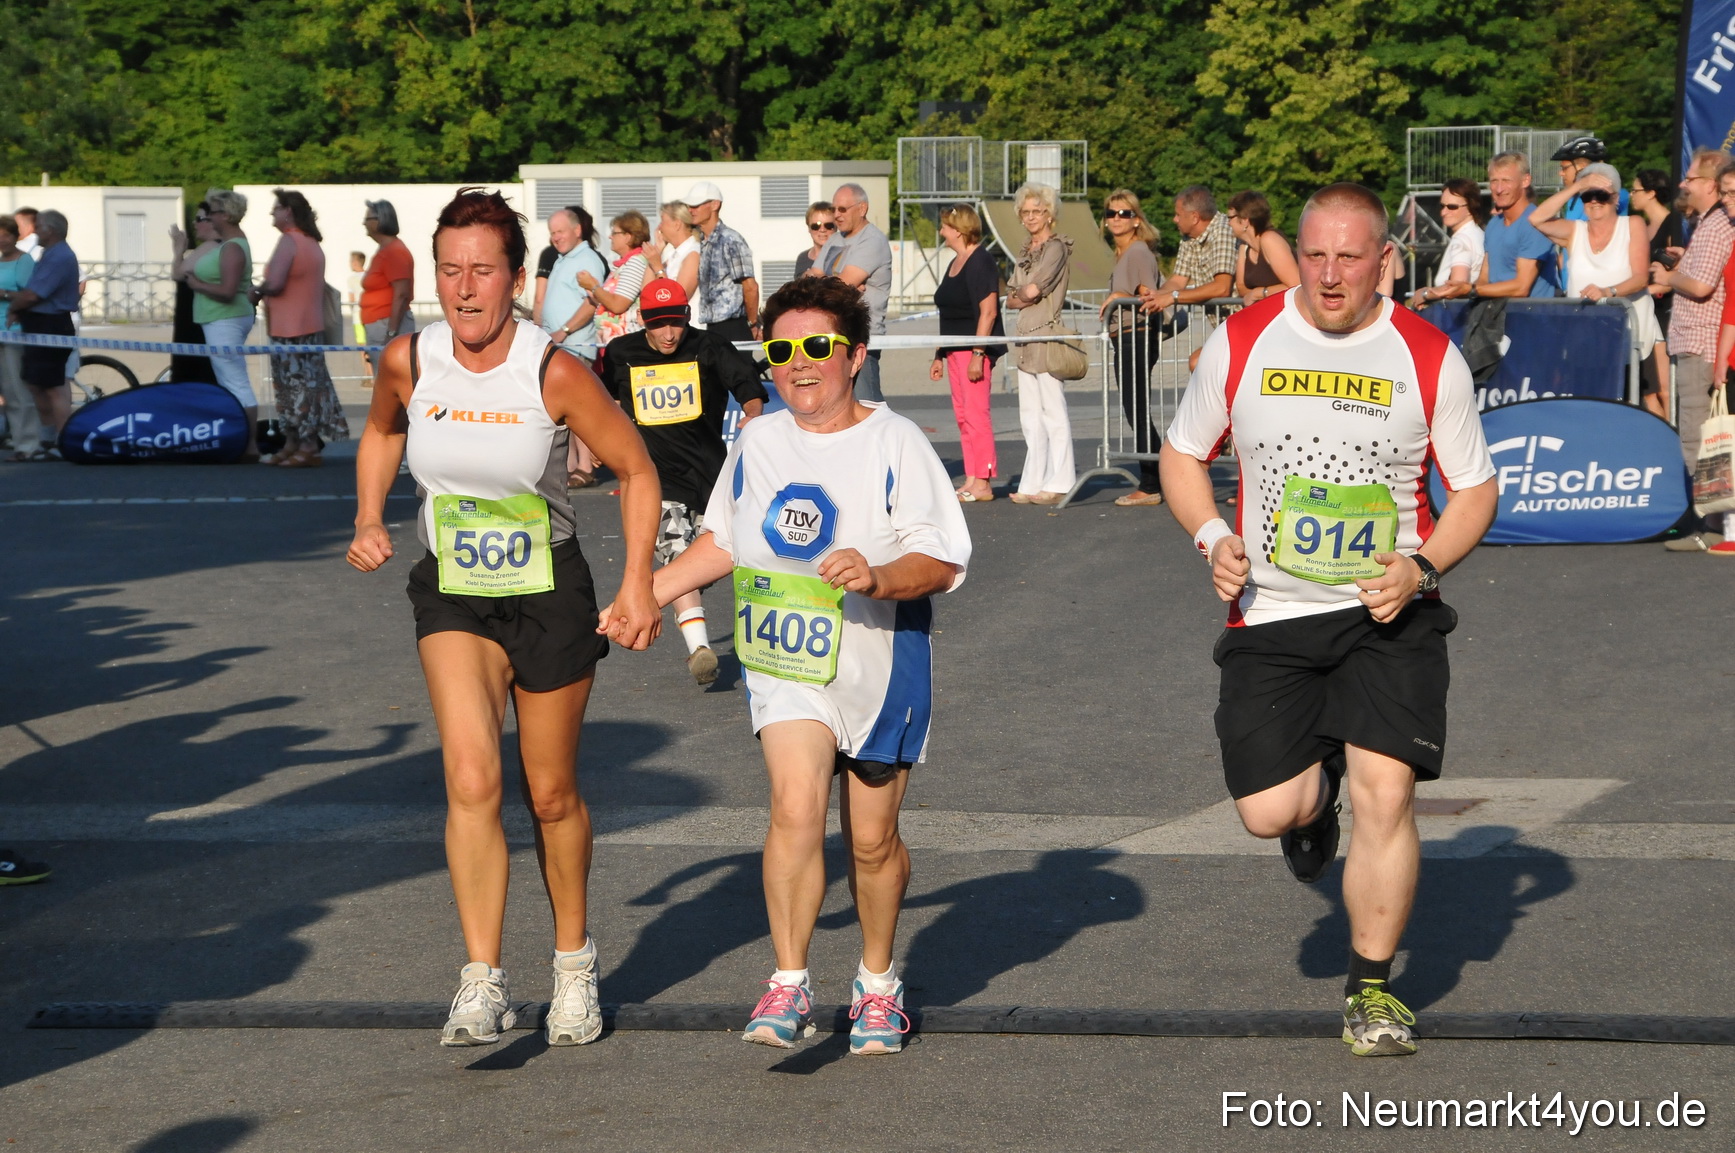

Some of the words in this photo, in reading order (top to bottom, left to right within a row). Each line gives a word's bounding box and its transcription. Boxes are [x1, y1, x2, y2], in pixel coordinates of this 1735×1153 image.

[1268, 372, 1381, 400] ONLINE
[636, 384, 694, 410] 1091
[451, 409, 524, 424] KLEBL
[1332, 400, 1390, 421] Germany
[111, 418, 225, 454] Fischer
[1499, 461, 1662, 495] Fischer
[1300, 495, 1342, 509] firmenlauf
[1511, 494, 1651, 513] AUTOMOBILE
[784, 508, 819, 528] TÜV
[787, 531, 808, 542] SÜD
[1294, 516, 1376, 559] 914
[454, 530, 532, 571] 560
[1291, 564, 1314, 573] ONLINE
[1306, 557, 1326, 567] Ronny
[469, 571, 495, 579] Susanna
[496, 571, 520, 579] Zrenner
[738, 604, 833, 658] 1408
[759, 649, 776, 659] Christa
[745, 654, 754, 662] TÜV
[766, 659, 778, 668] AUTO
[779, 662, 803, 672] SERVICE
[804, 667, 821, 675] GmbH
